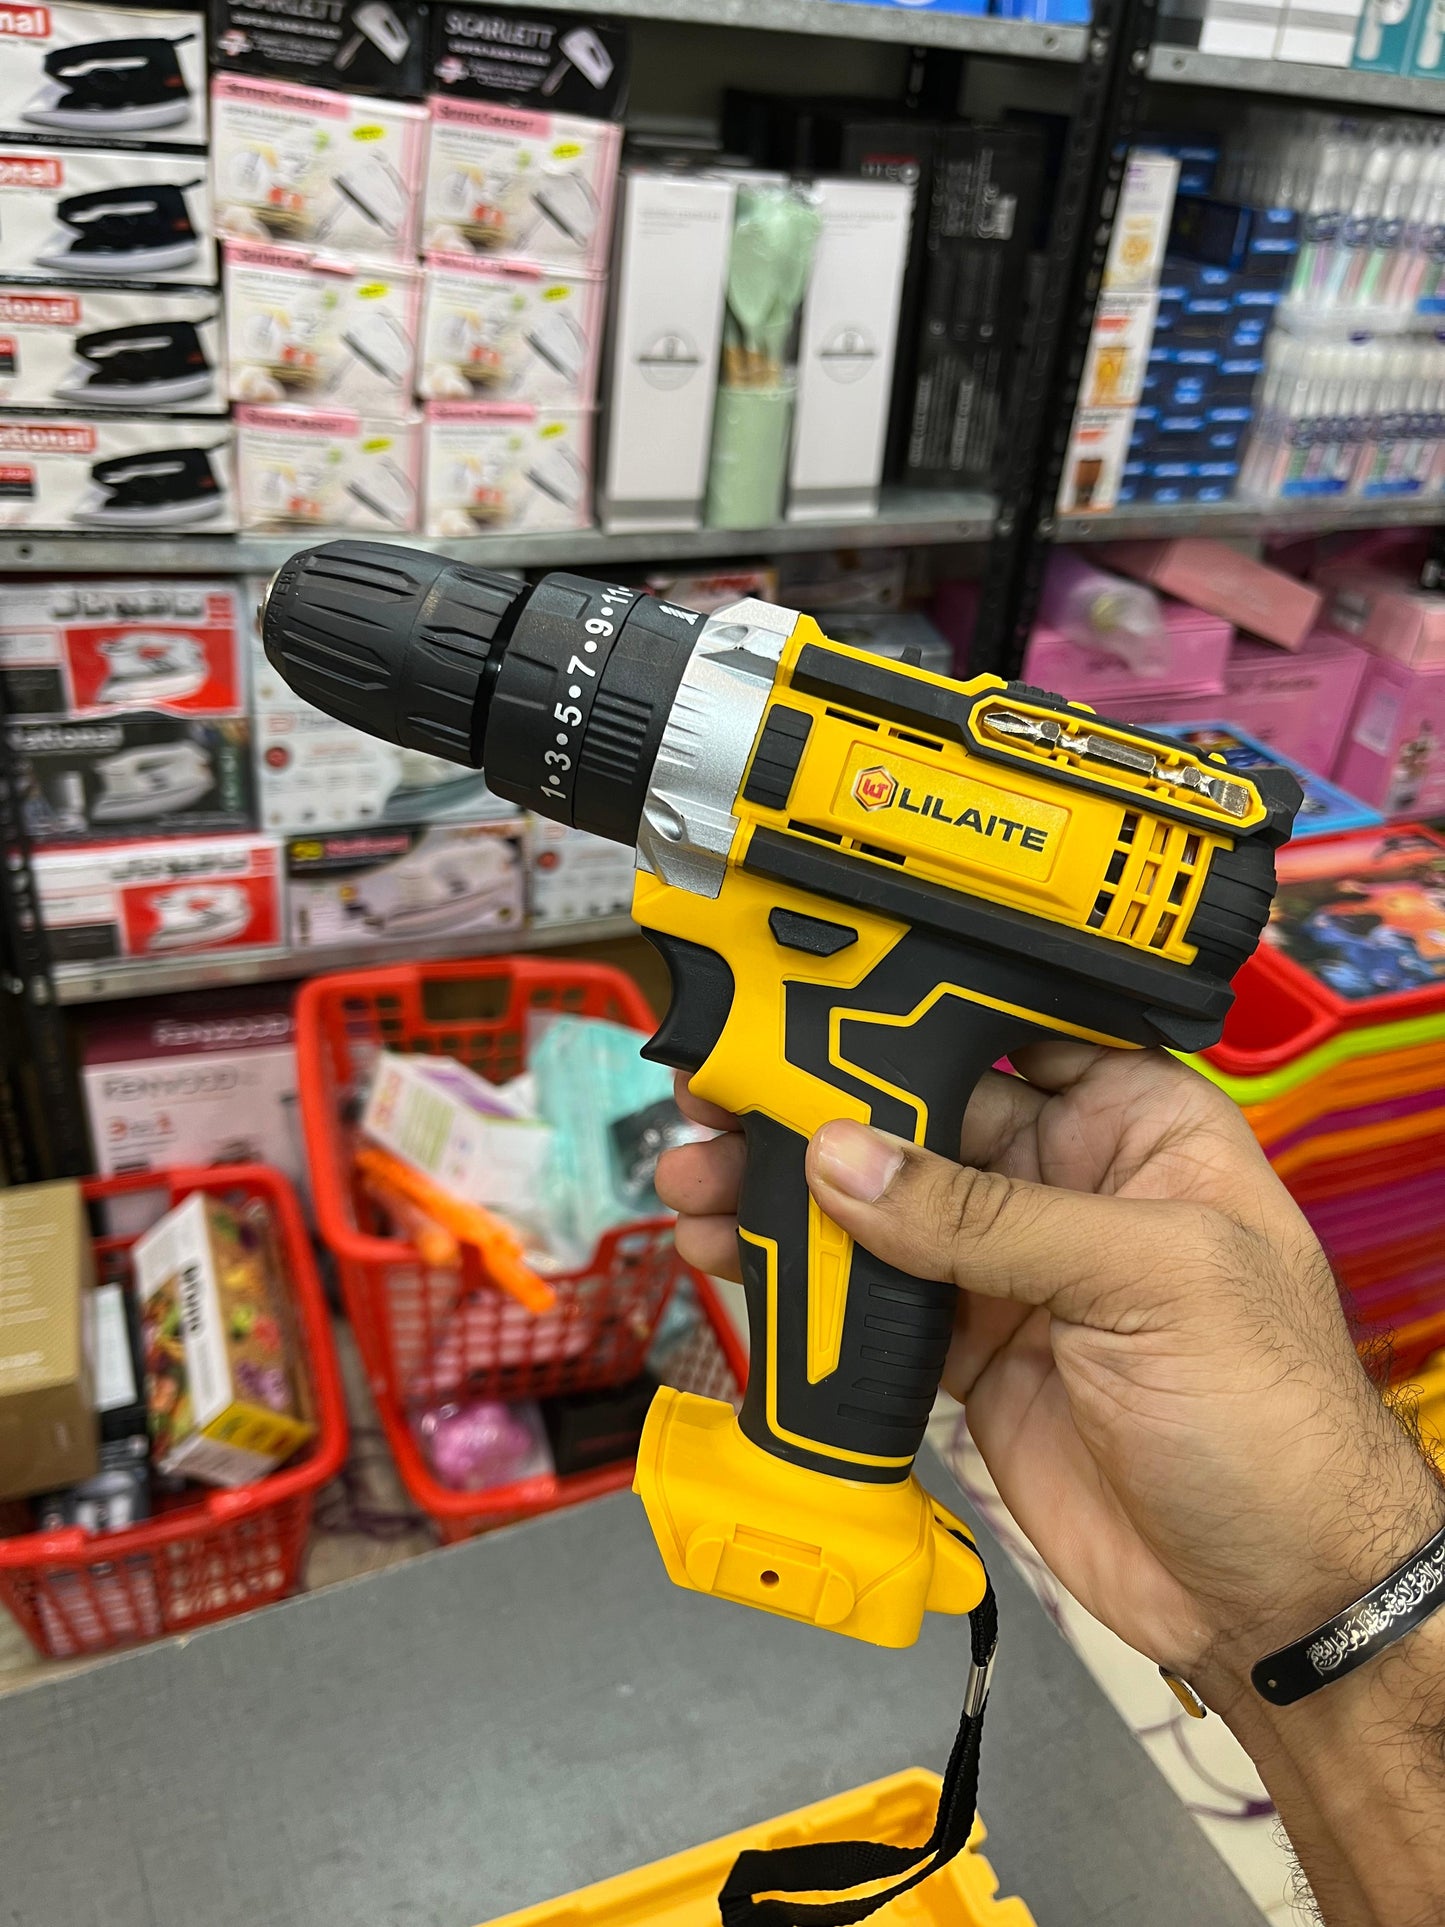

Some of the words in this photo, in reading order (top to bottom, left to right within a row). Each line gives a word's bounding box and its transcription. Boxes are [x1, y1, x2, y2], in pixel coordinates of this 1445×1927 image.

[445, 9, 557, 50] SCARLETT
[585, 618, 614, 637] 9
[567, 655, 596, 678] 7
[554, 702, 583, 727] 5
[544, 750, 571, 771] 3
[541, 784, 566, 799] 1
[898, 787, 1049, 853] LILAITE
